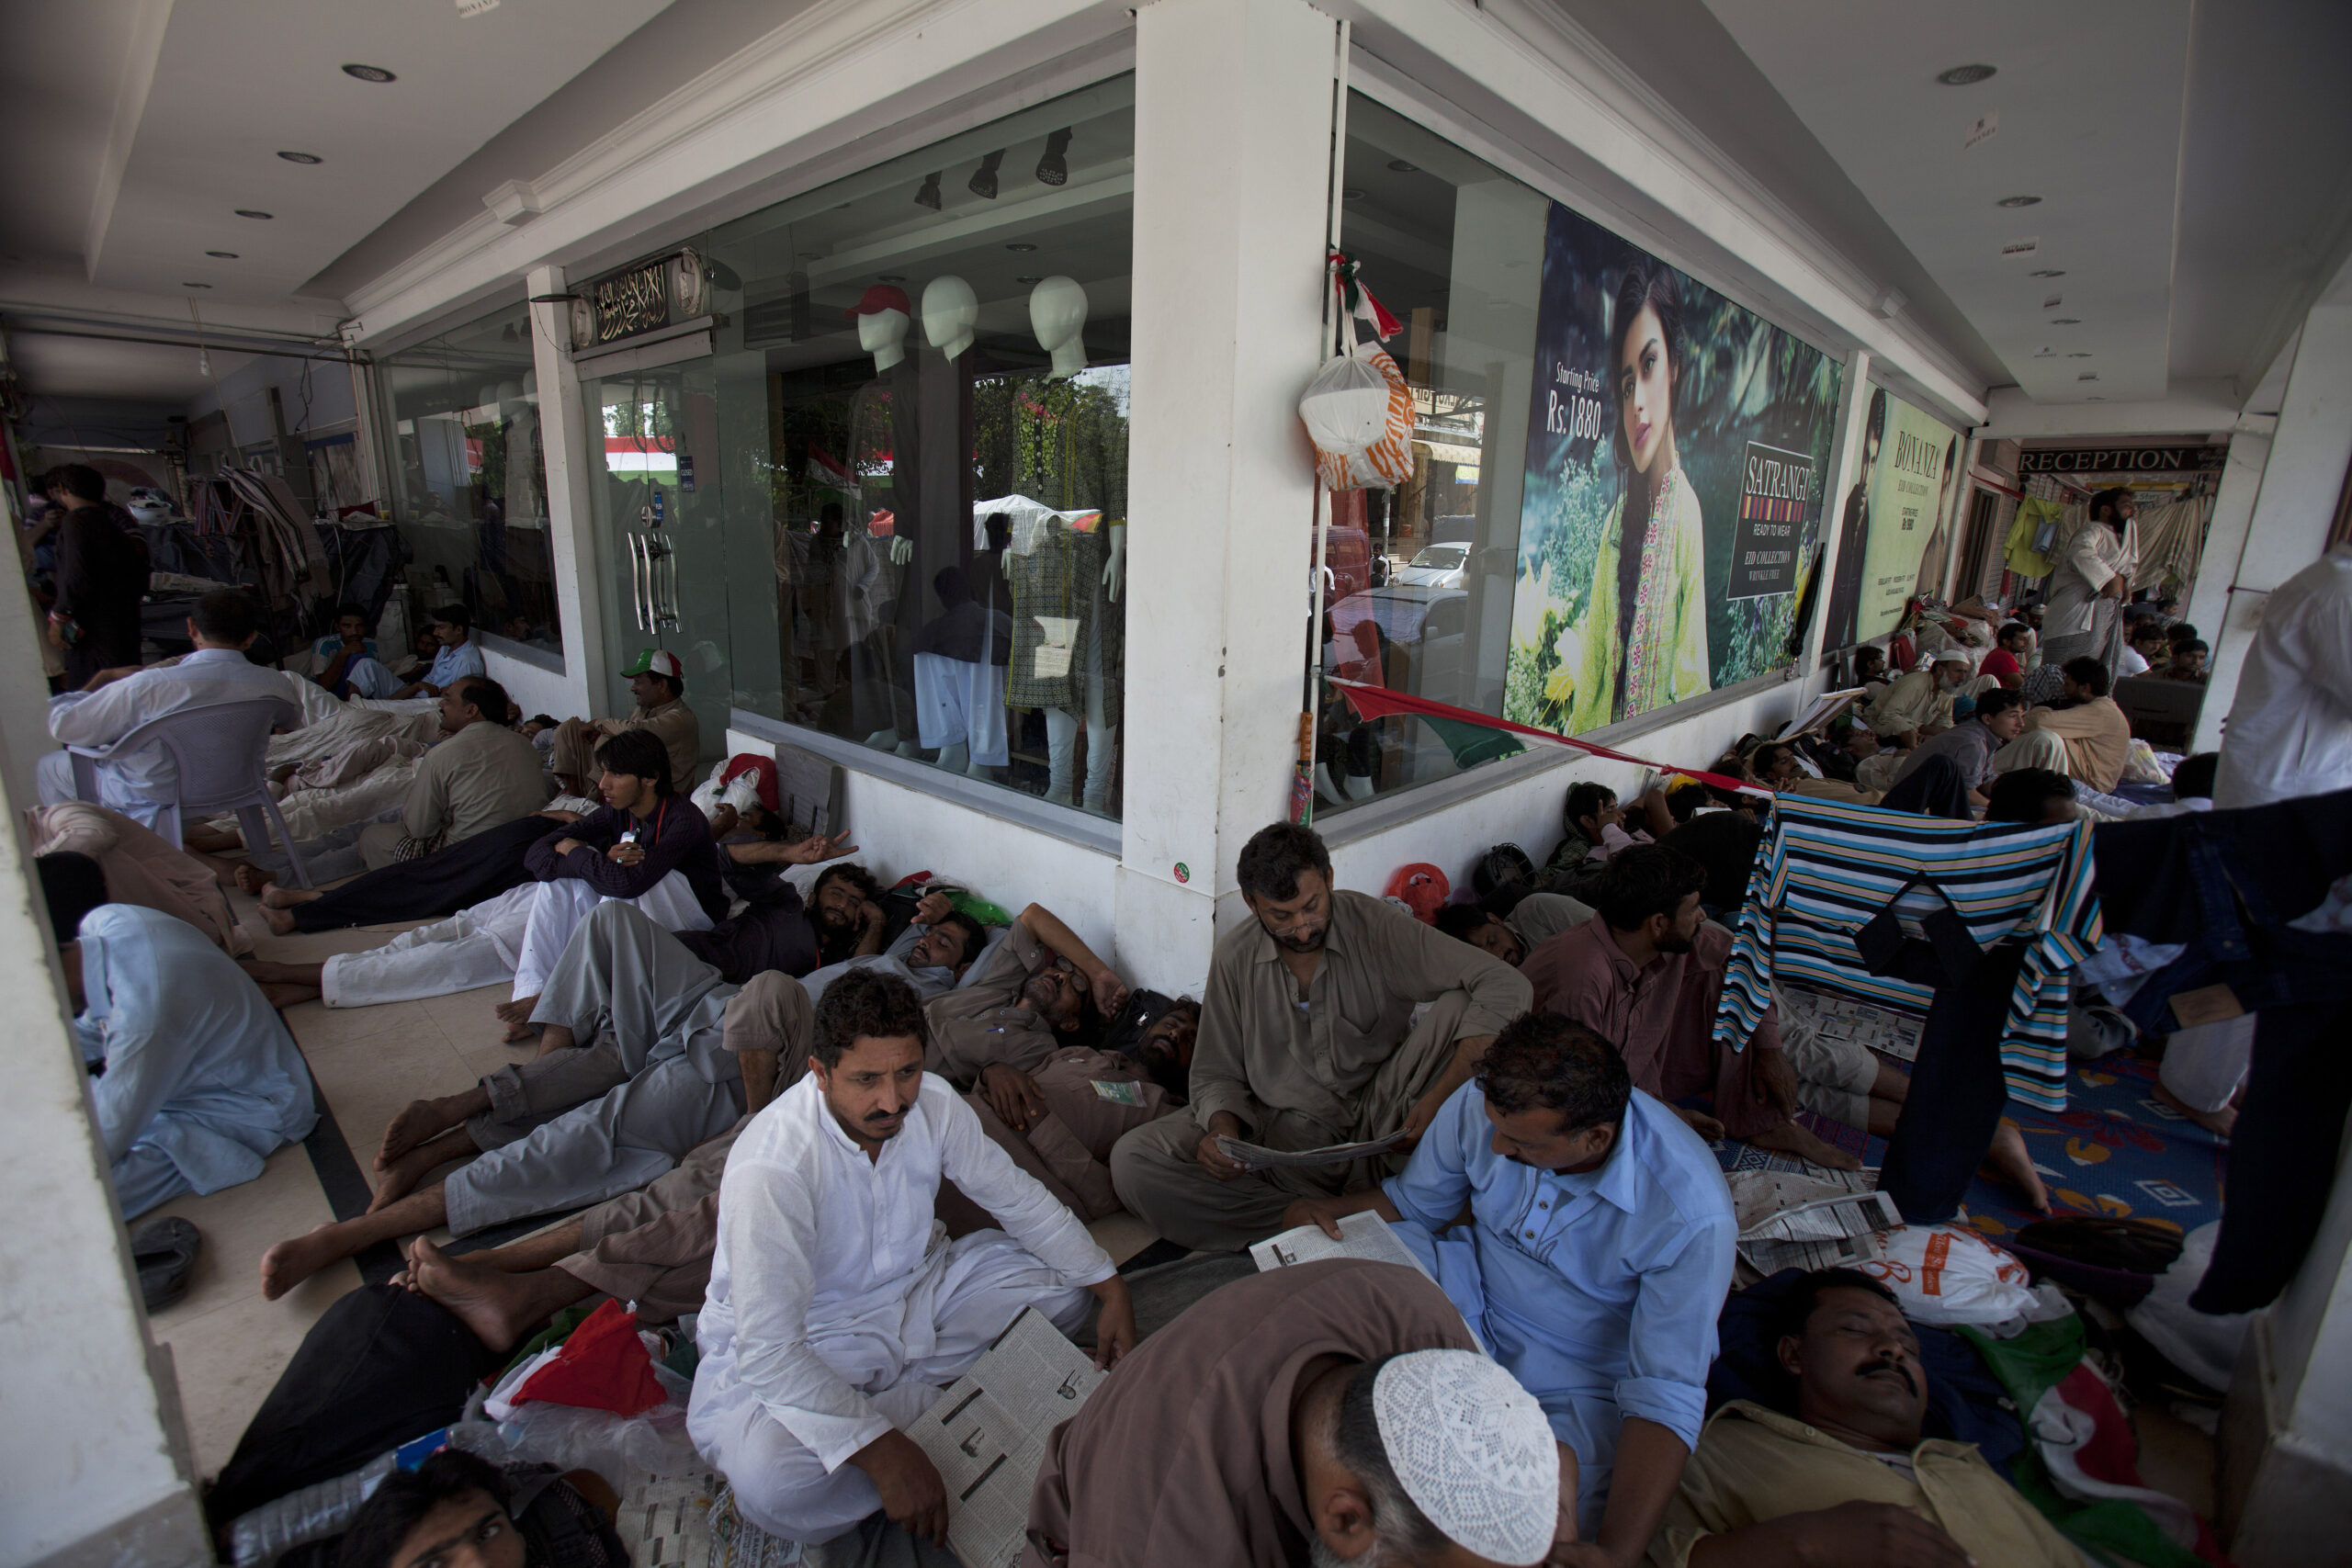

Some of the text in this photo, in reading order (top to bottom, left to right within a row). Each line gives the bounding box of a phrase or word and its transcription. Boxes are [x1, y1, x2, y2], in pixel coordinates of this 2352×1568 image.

[1555, 362, 1600, 393] Starting Price
[1547, 389, 1602, 441] Rs.1880
[1894, 431, 1939, 479] BONANZA
[2018, 449, 2185, 472] RECEPTION
[1746, 455, 1811, 502] SATRANGI
[1753, 523, 1792, 537] READY TO WEAR
[1744, 550, 1792, 566] EID COLLECTION
